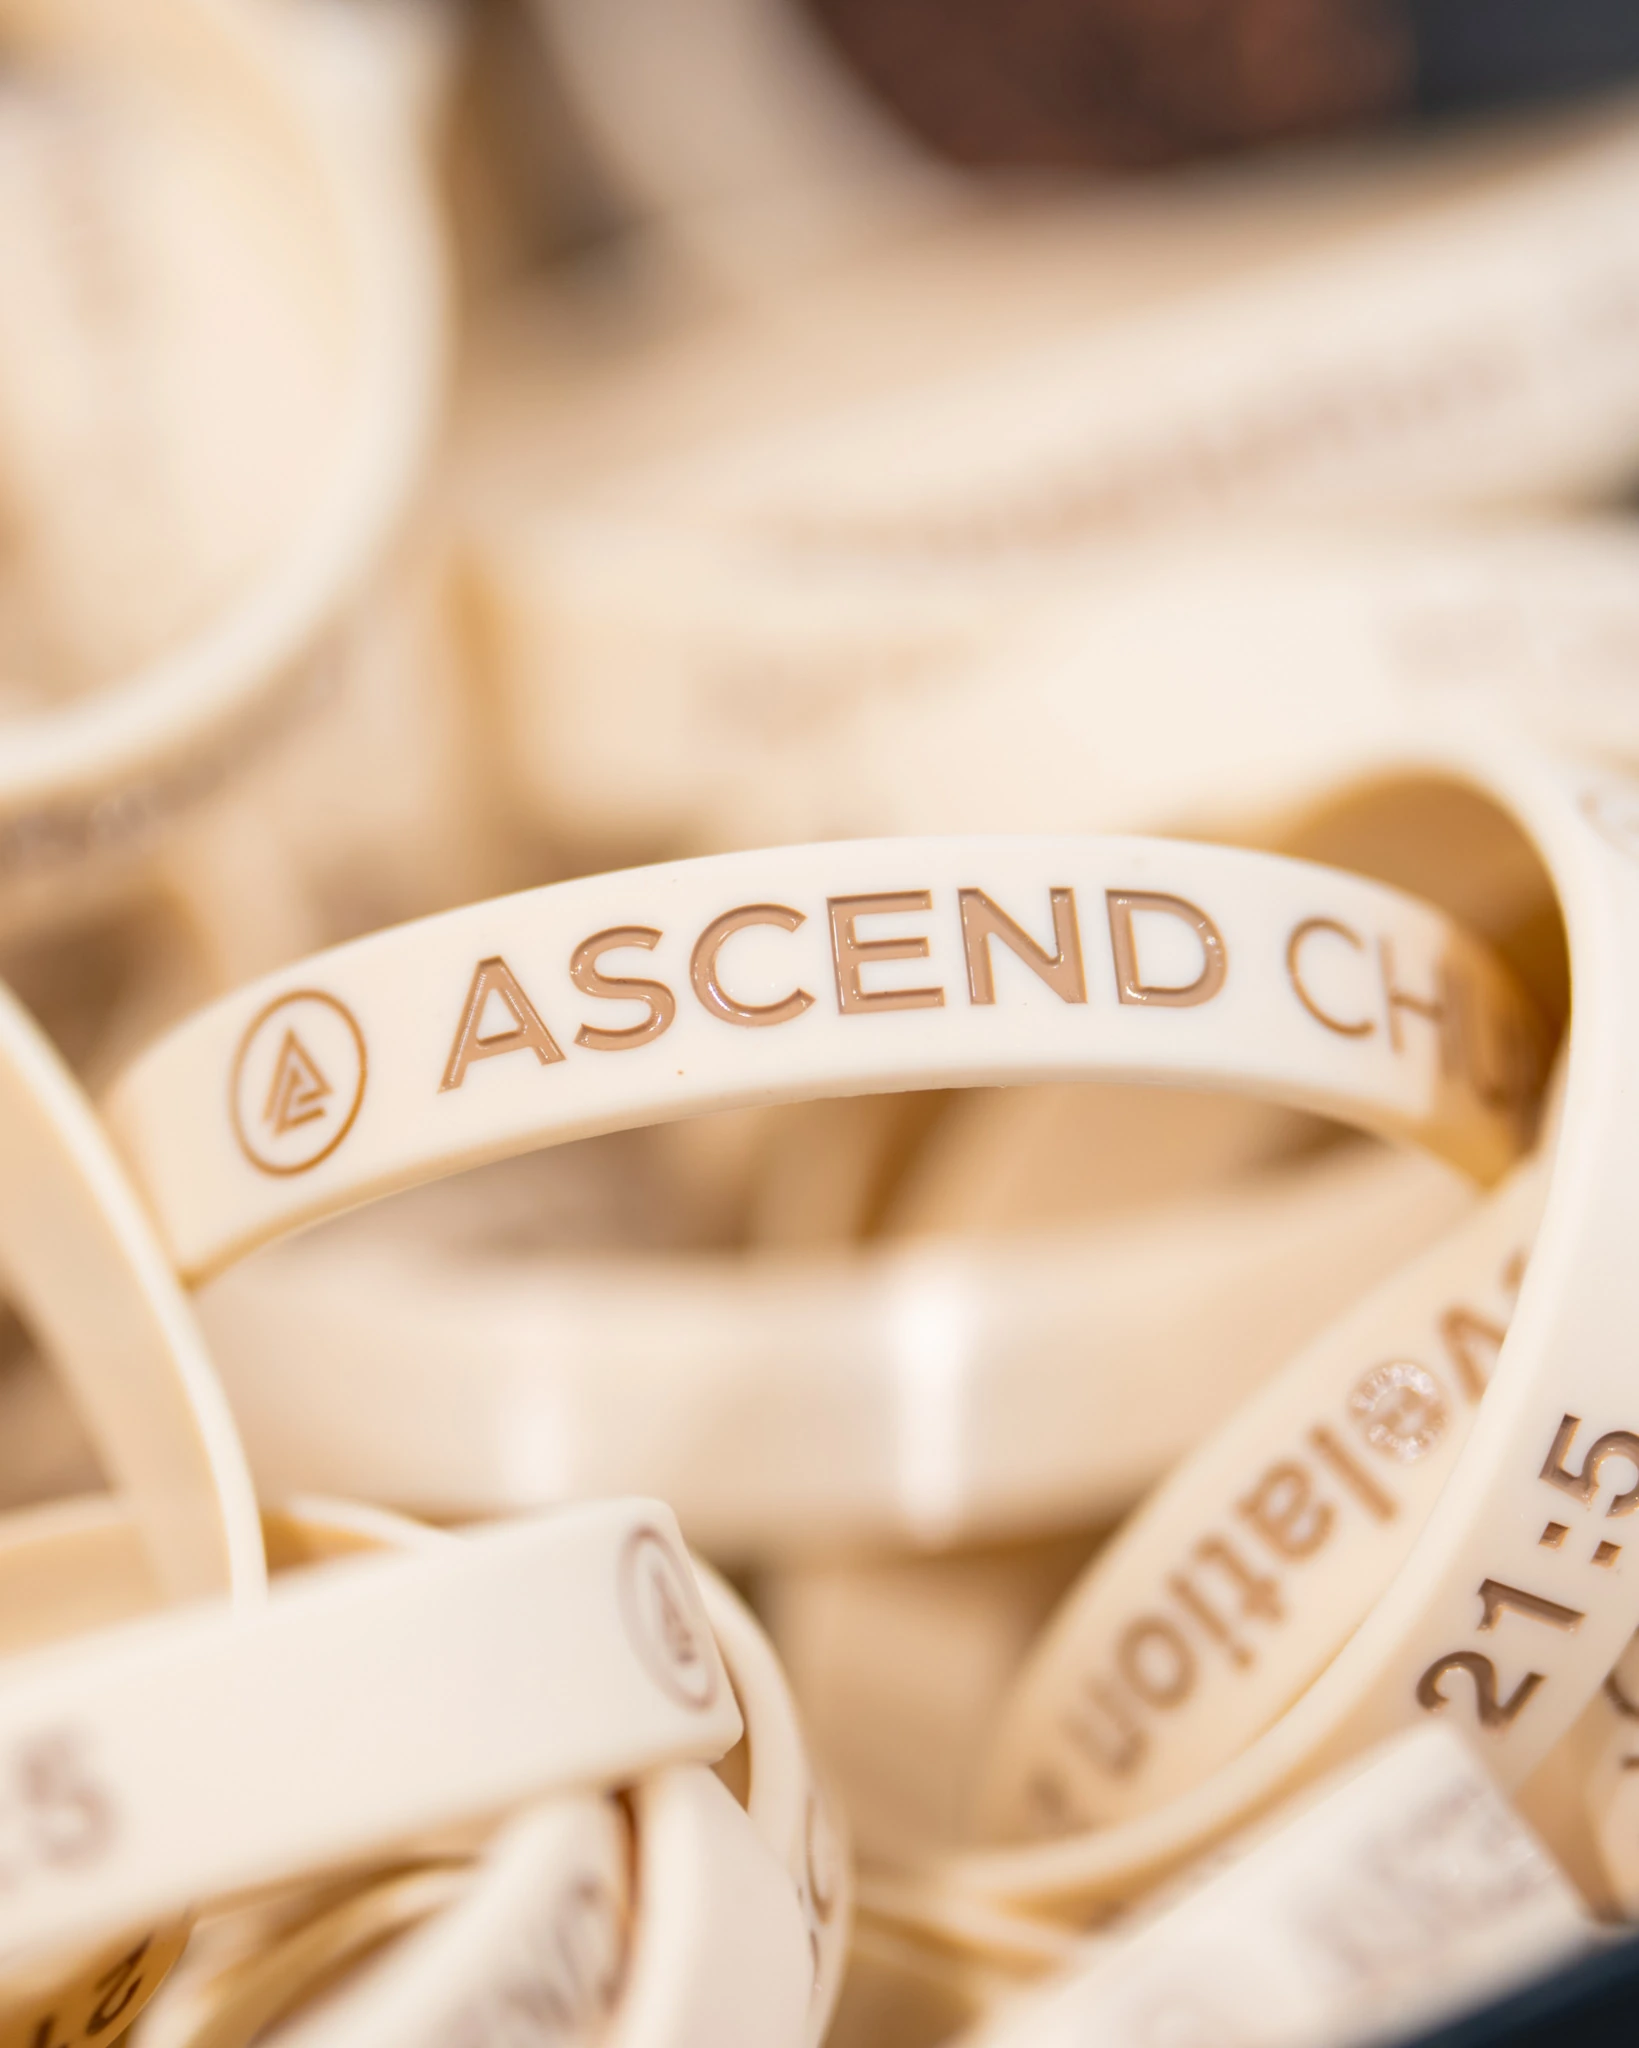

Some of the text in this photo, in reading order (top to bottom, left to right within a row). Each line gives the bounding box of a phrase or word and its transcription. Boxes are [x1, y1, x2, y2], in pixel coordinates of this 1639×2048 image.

[437, 887, 1229, 1094] ASCEND
[1060, 1246, 1532, 1780] velation
[1416, 1412, 1639, 1732] 21:5
